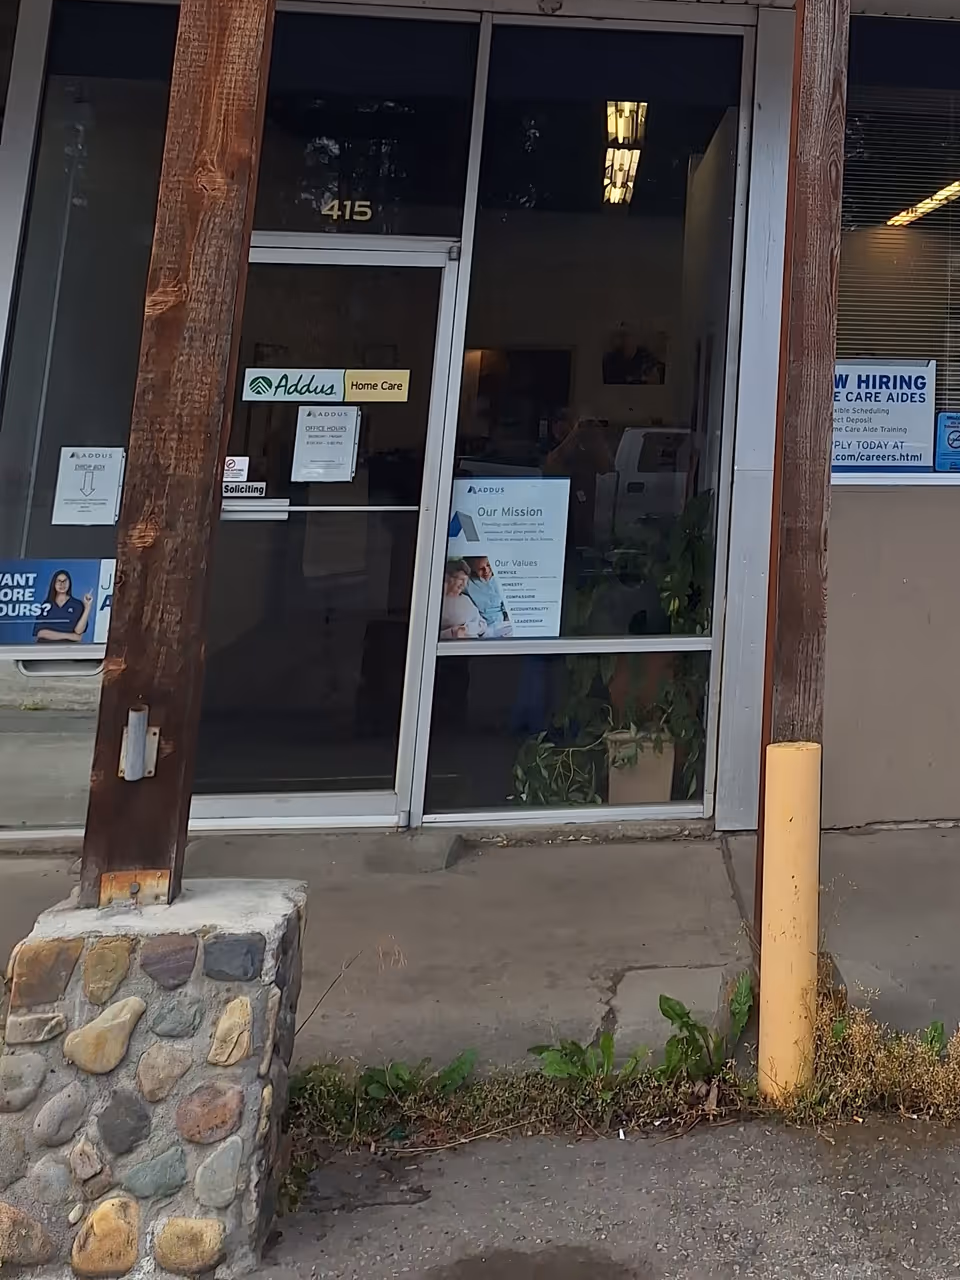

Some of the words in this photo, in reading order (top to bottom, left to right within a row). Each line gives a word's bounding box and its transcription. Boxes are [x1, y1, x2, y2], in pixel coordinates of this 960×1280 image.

[321, 199, 373, 220] 415
[273, 373, 336, 397] Addus
[350, 381, 378, 391] Home
[381, 381, 403, 391] Care
[857, 374, 927, 390] HIRING
[846, 392, 882, 402] CARE
[886, 393, 926, 403] AIDES
[852, 407, 890, 415] Scheduling
[846, 417, 872, 425] Deposit
[880, 426, 908, 434] Training
[832, 441, 852, 449] PLY
[856, 441, 889, 450] TODAY
[892, 441, 905, 449] AT
[224, 484, 264, 495] Soliciting
[477, 507, 497, 517] Our
[501, 507, 543, 517] Mission
[494, 559, 509, 567] Our
[512, 559, 538, 567] Values
[0, 573, 37, 586] ANT
[0, 589, 35, 601] ORE
